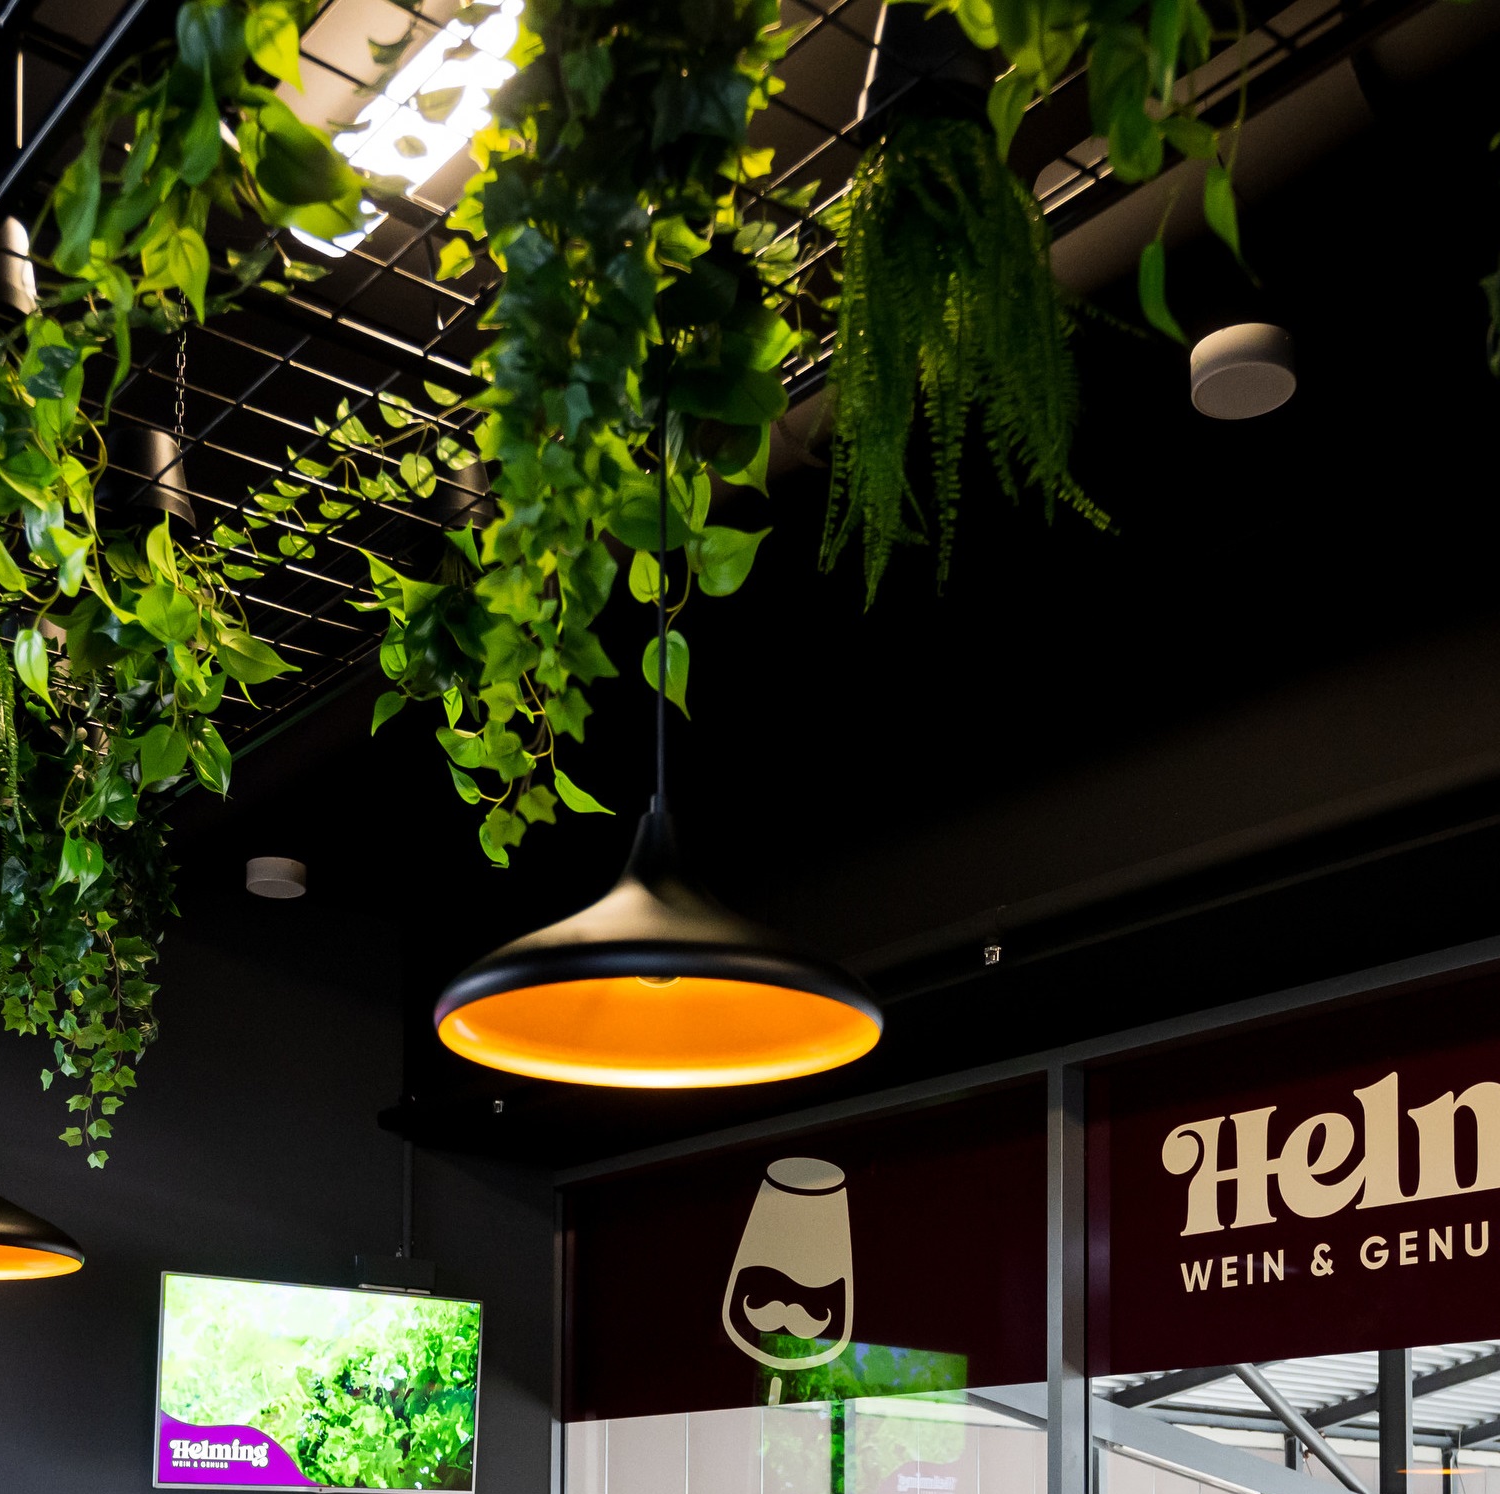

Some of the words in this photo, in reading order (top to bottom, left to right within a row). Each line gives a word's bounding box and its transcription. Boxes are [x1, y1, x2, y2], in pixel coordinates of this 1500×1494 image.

[1180, 1249, 1285, 1293] WEIN
[1310, 1243, 1335, 1277] &
[169, 1438, 269, 1467] Helming
